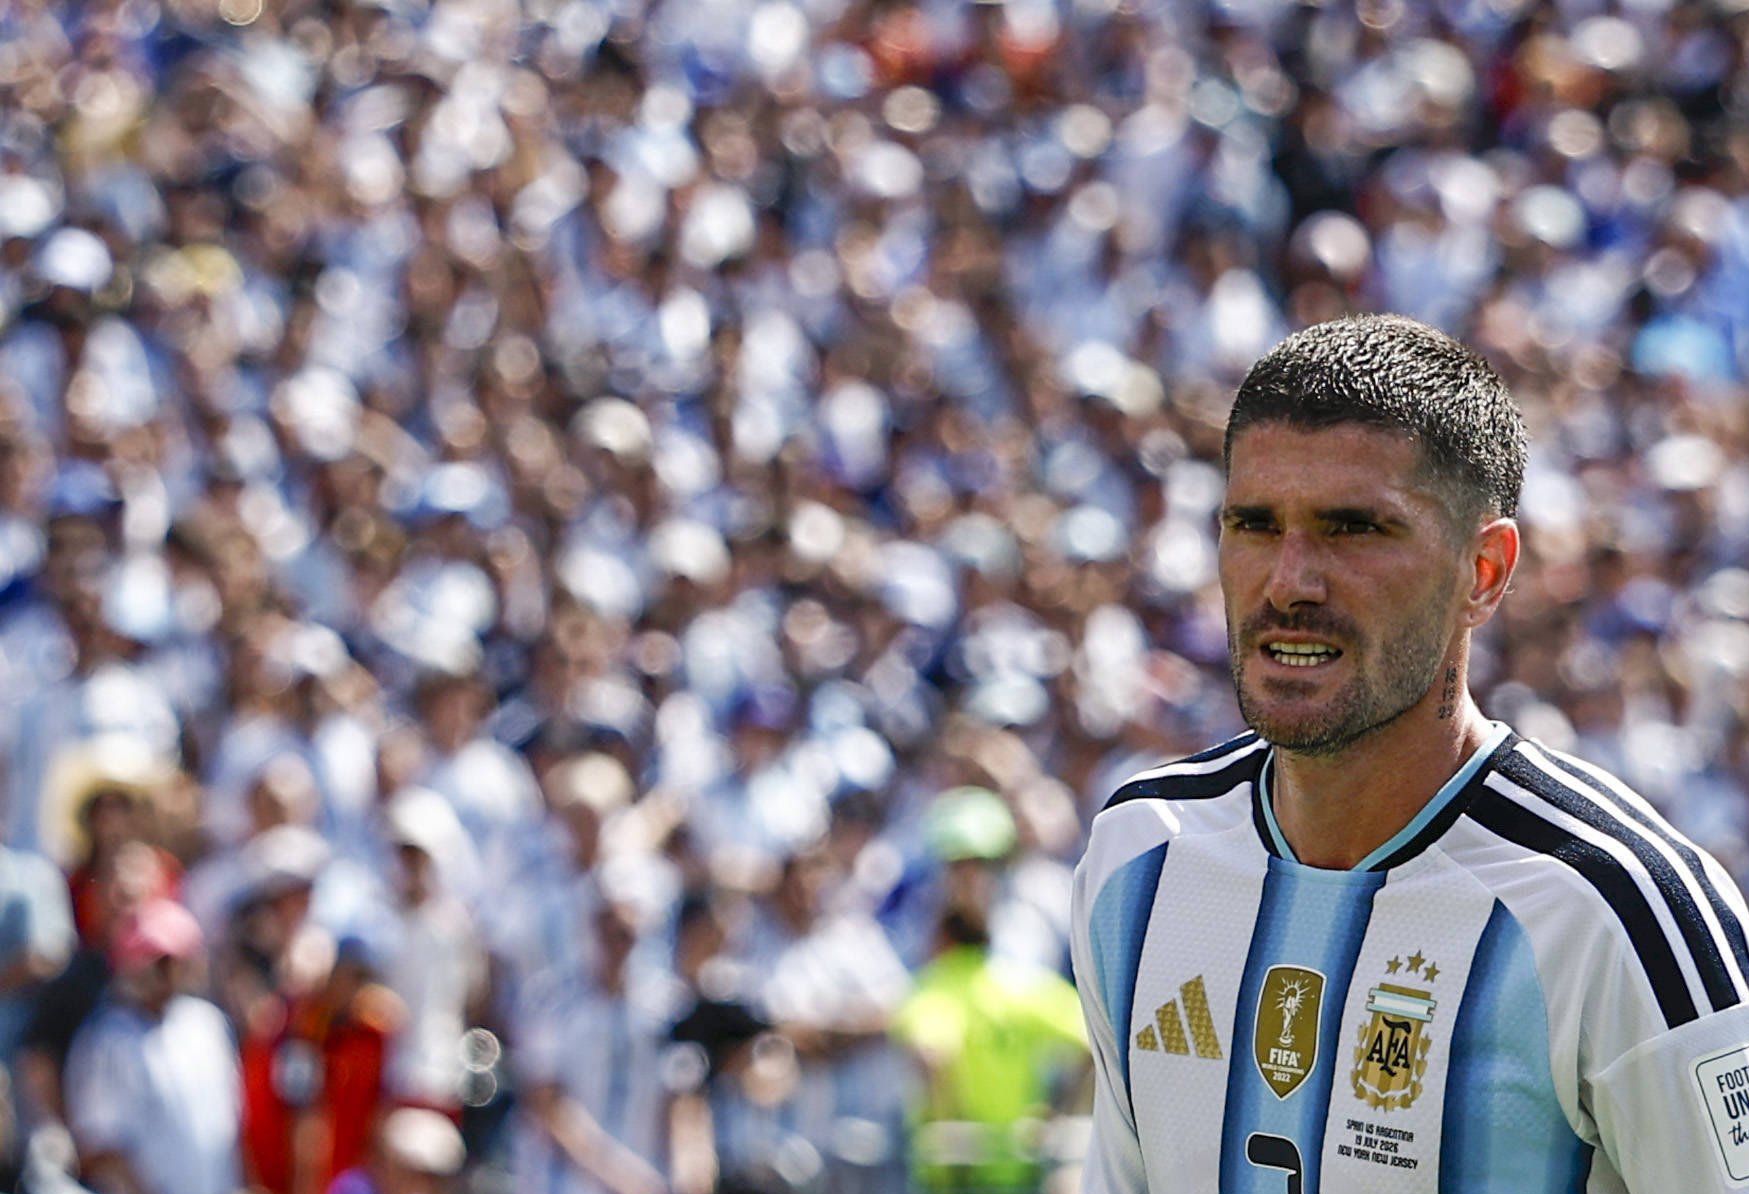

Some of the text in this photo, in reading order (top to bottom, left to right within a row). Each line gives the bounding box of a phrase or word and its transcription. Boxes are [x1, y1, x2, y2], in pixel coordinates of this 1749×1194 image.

[1270, 1048, 1299, 1068] FIFA
[1272, 1071, 1291, 1083] 2022
[1390, 1155, 1419, 1170] JERSEY
